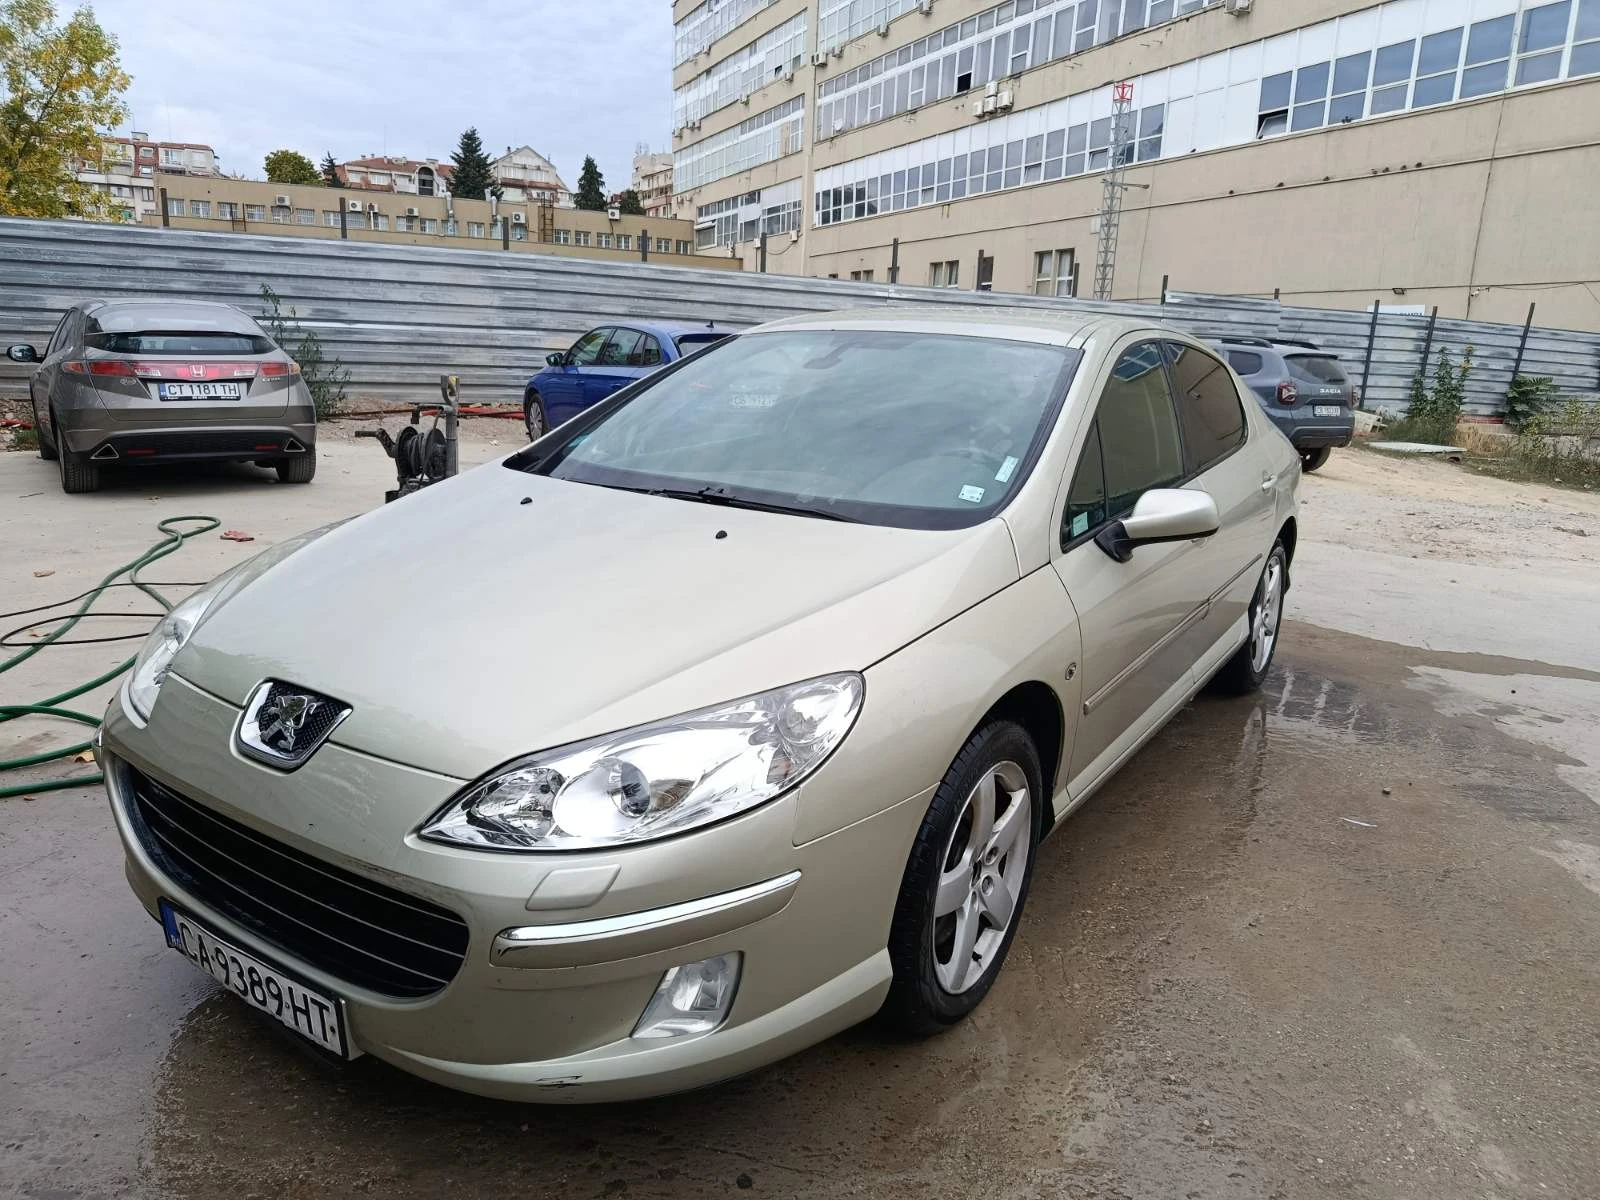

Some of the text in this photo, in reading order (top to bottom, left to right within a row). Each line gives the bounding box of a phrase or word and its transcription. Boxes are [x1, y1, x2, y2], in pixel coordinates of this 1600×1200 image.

[167, 384, 184, 395] CT
[189, 384, 218, 395] 1181
[220, 384, 237, 395] TH
[179, 922, 330, 1043] CA 9389 HT
